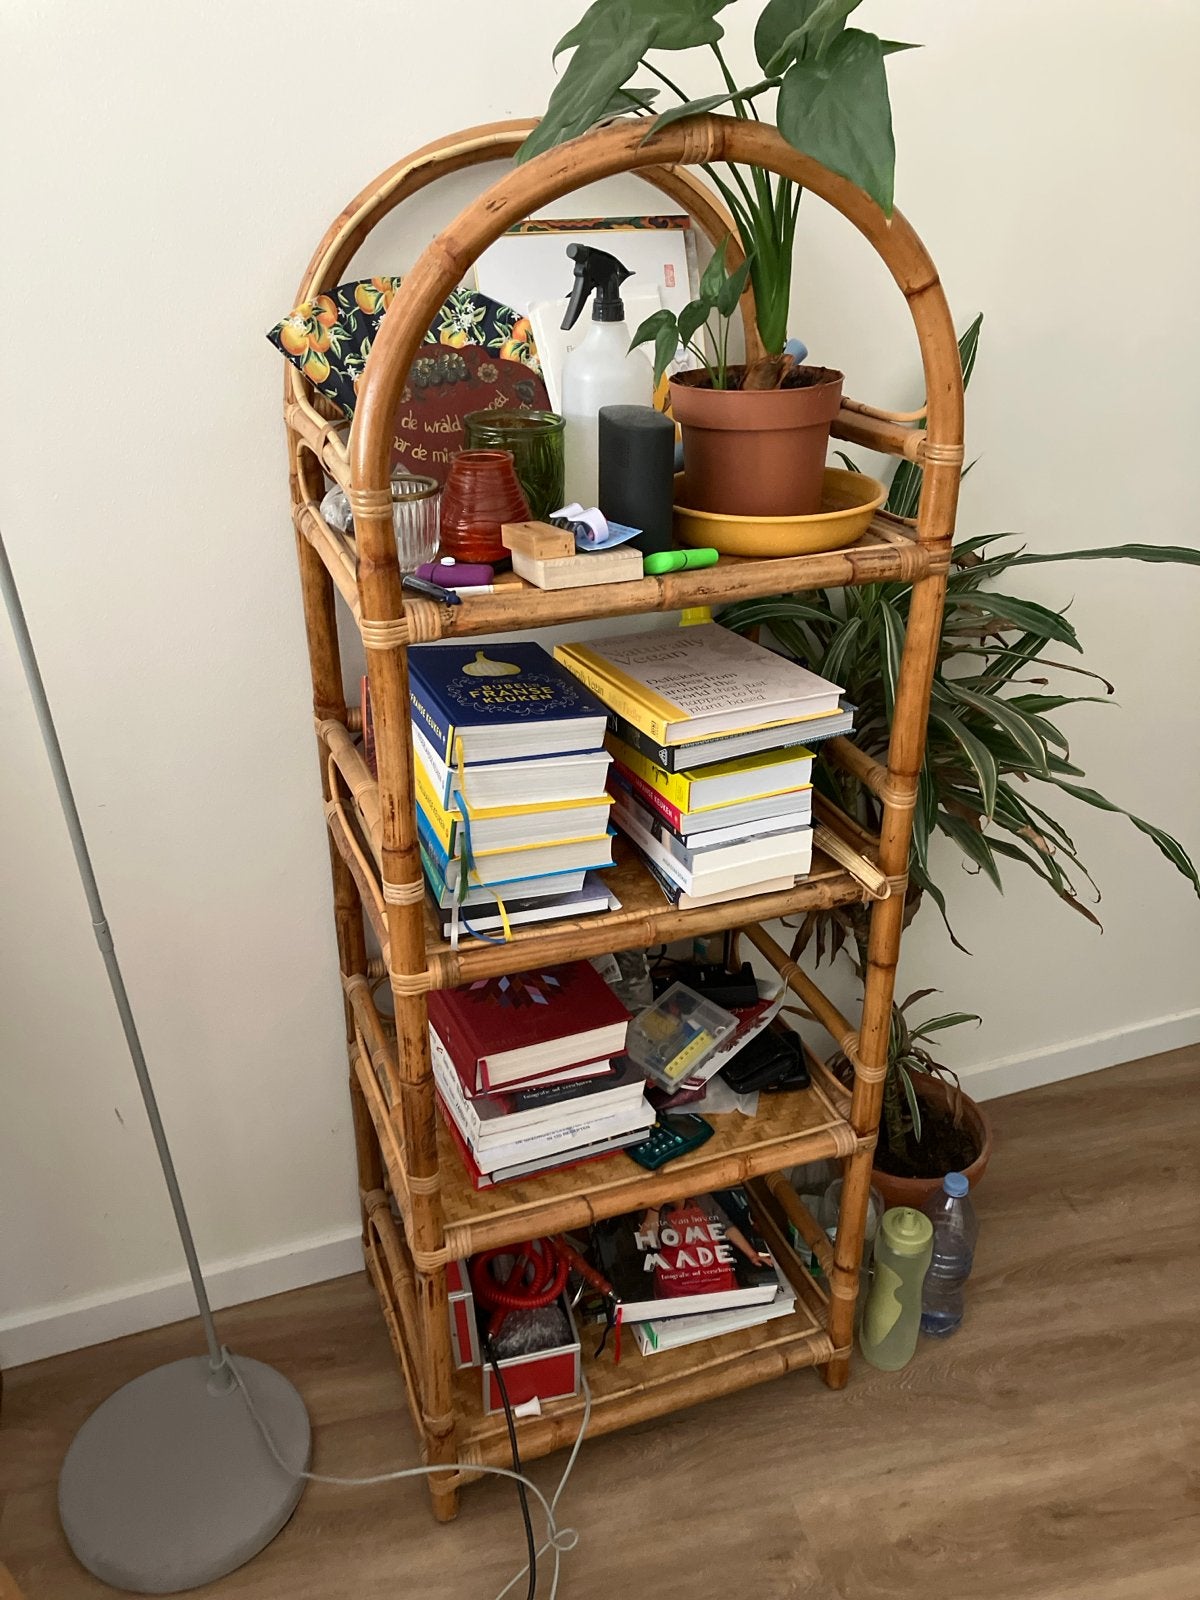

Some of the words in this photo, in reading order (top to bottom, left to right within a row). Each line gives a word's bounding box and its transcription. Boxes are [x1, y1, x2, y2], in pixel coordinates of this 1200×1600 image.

[401, 410, 418, 431] de
[424, 414, 463, 434] wrâld
[411, 443, 428, 461] de
[613, 650, 689, 666] Vegan
[703, 672, 738, 682] from
[469, 686, 555, 699] FRANSE
[664, 682, 711, 695] around
[671, 689, 711, 701] world
[712, 685, 740, 694] that
[482, 693, 553, 704] KEUKEN
[679, 694, 730, 707] happen
[633, 1223, 728, 1251] HOME
[643, 1244, 737, 1272] MADE
